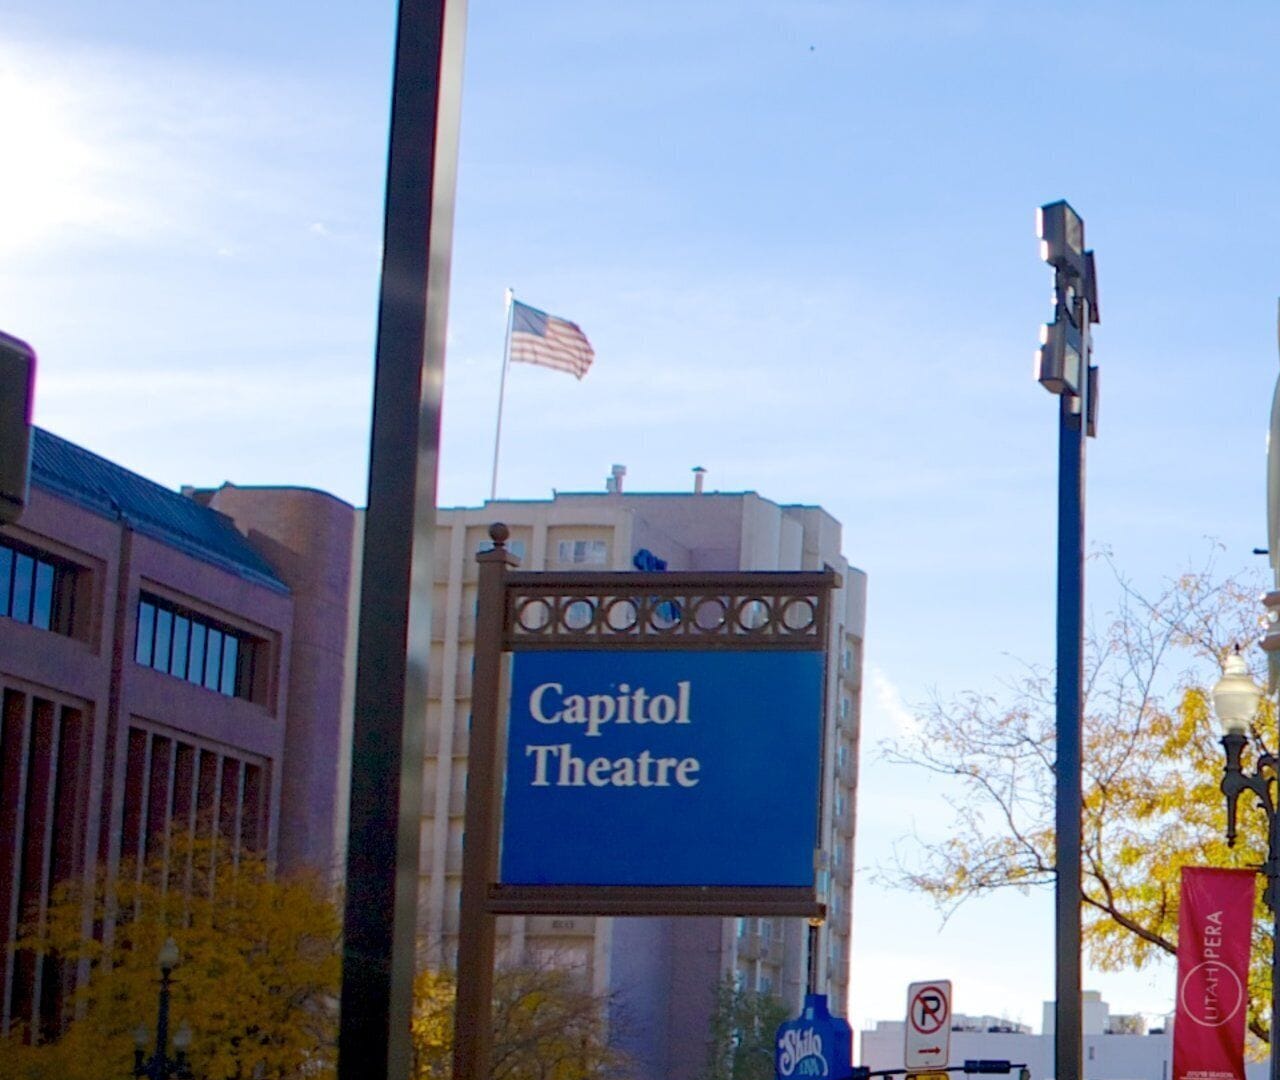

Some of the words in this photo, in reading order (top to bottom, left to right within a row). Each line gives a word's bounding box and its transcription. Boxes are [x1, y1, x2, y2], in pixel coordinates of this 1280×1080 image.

[528, 681, 692, 737] Capitol
[525, 743, 701, 788] Theatre
[1203, 966, 1219, 1022] UTAH
[779, 1026, 828, 1076] Shilo
